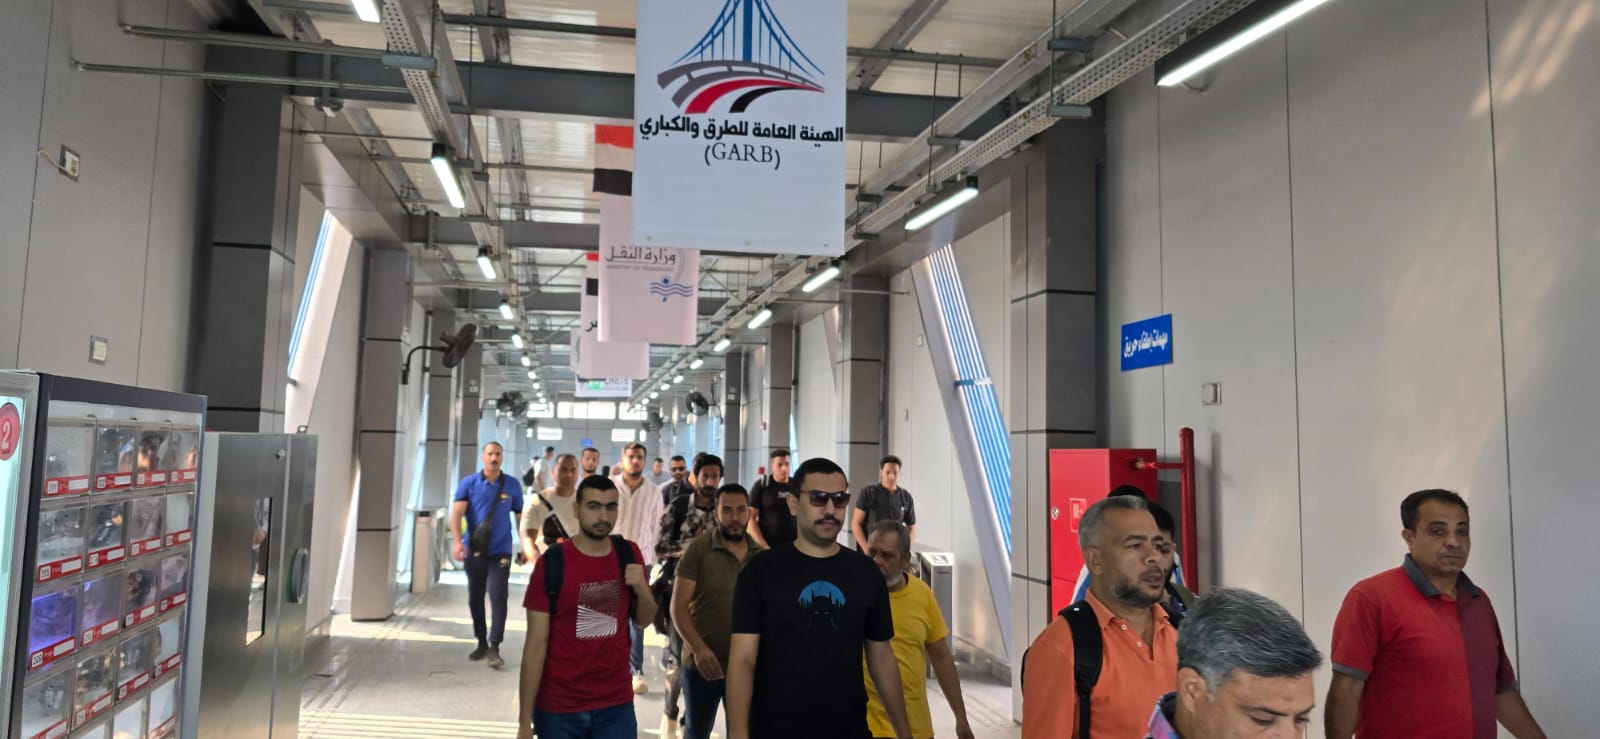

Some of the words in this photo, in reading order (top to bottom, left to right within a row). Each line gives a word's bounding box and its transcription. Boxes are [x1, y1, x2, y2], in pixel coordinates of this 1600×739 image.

[639, 114, 700, 140] والكباري
[703, 117, 749, 140] للطرق
[752, 121, 796, 140] العامة
[800, 125, 844, 148] الهيئة
[704, 142, 781, 171] (GARB)
[605, 245, 642, 262] النقل
[644, 247, 677, 265] وزارة
[1124, 336, 1138, 358] حريق
[1, 420, 10, 449] 2
